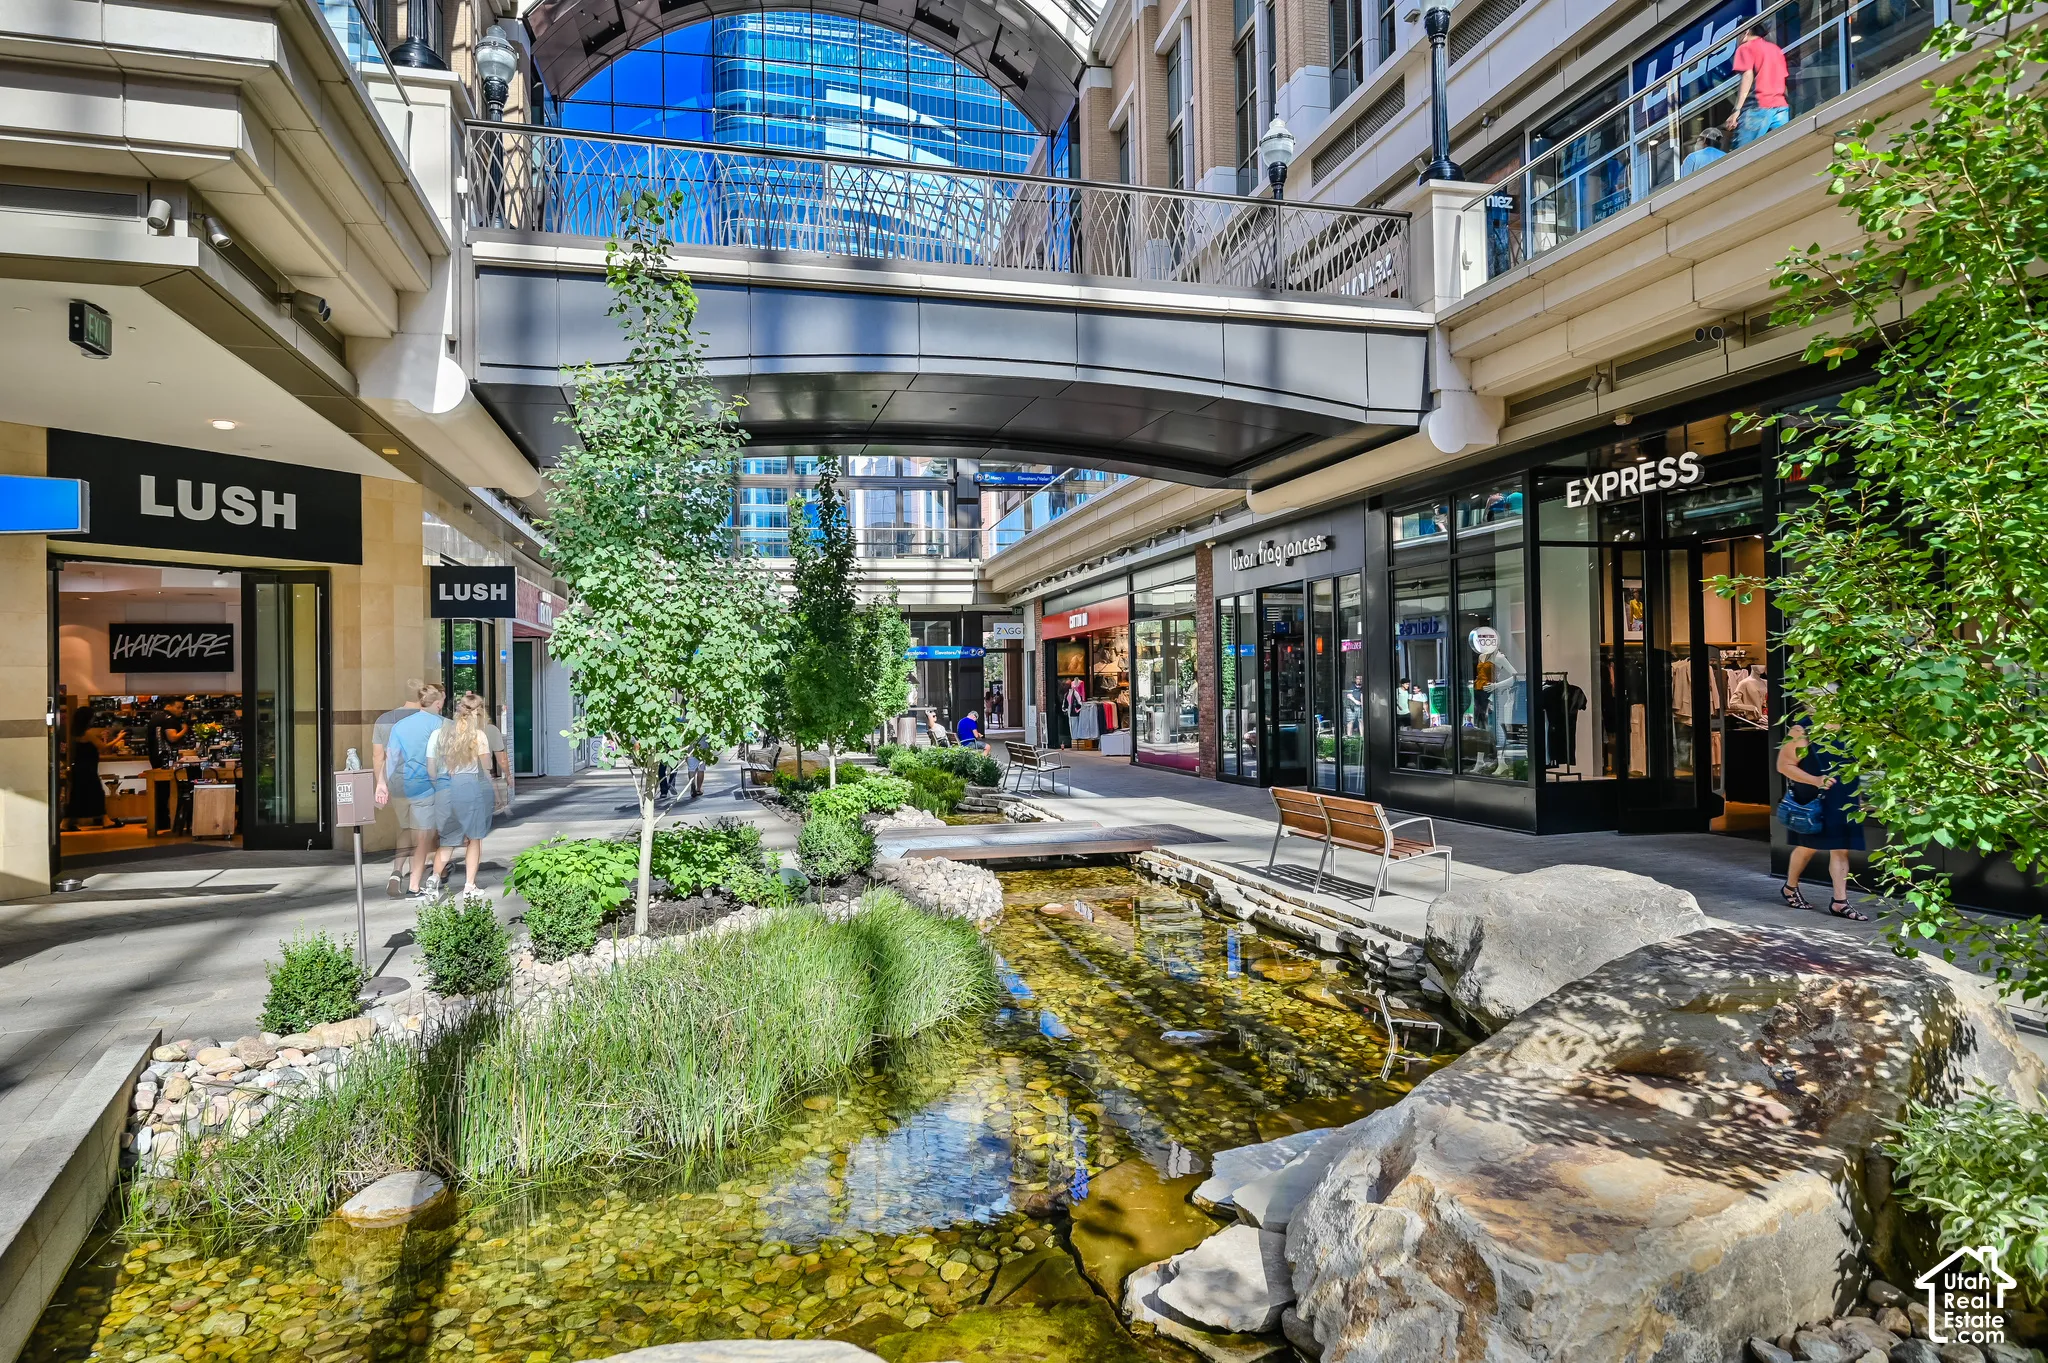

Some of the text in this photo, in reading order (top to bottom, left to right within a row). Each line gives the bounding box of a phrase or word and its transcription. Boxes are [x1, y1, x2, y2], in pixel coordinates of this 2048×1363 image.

[1642, 17, 1738, 112] Lids
[1560, 130, 1602, 174] Lids
[1614, 193, 1632, 205] SELEC
[88, 313, 107, 348] EXIT
[1566, 451, 1700, 508] EXPRESS
[140, 474, 297, 530] LUSH
[1258, 535, 1326, 567] fragrances
[439, 583, 507, 601] LUSH
[112, 633, 232, 660] HAIRCARE
[996, 627, 1022, 635] ZAGG
[337, 784, 352, 792] CITY
